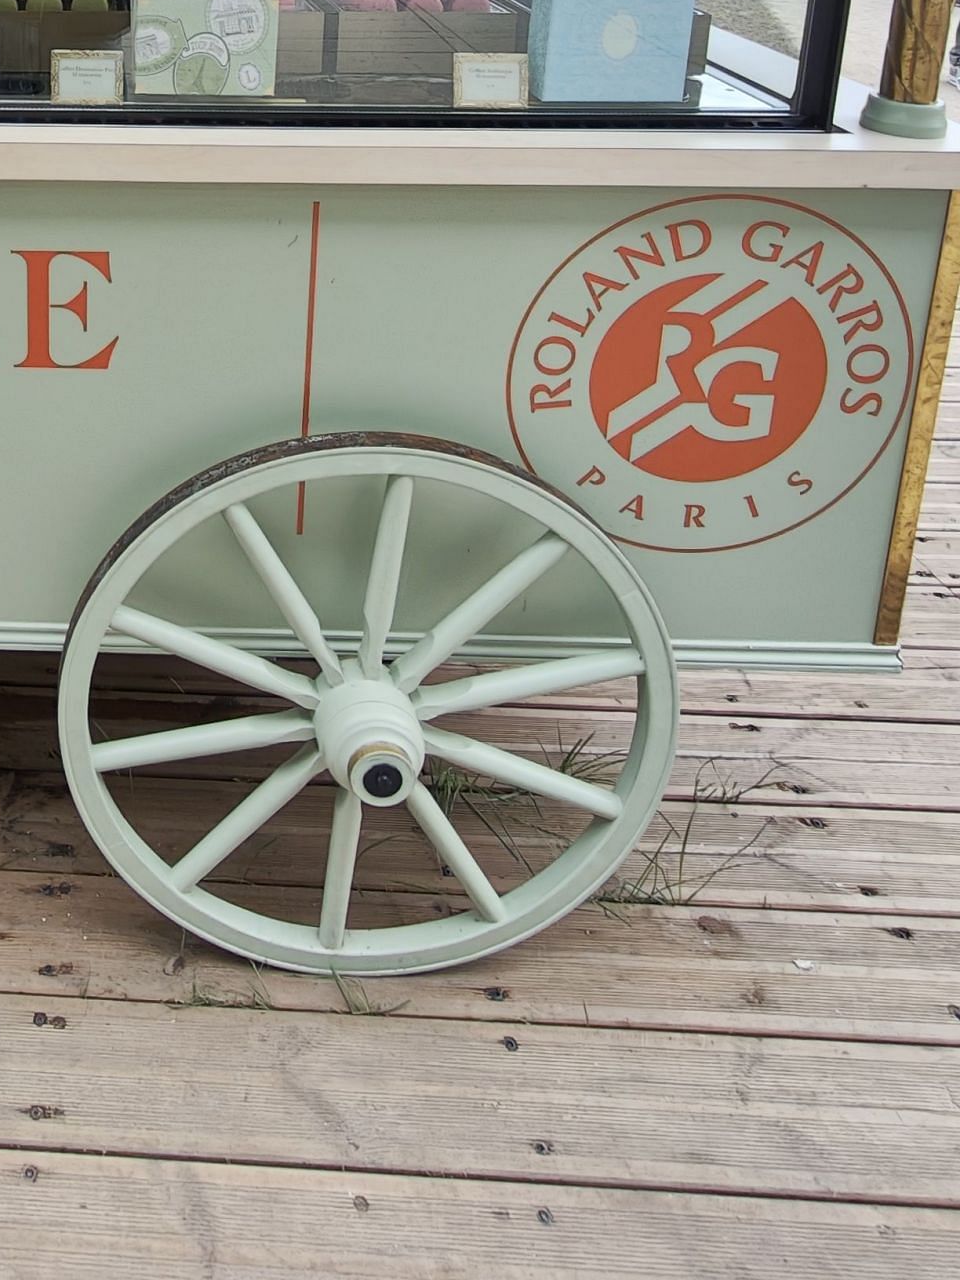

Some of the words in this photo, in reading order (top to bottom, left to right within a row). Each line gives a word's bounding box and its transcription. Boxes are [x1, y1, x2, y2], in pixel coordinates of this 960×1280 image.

[530, 220, 712, 413] ROLAND
[741, 220, 890, 418] GARROS
[576, 465, 813, 528] PARIS
